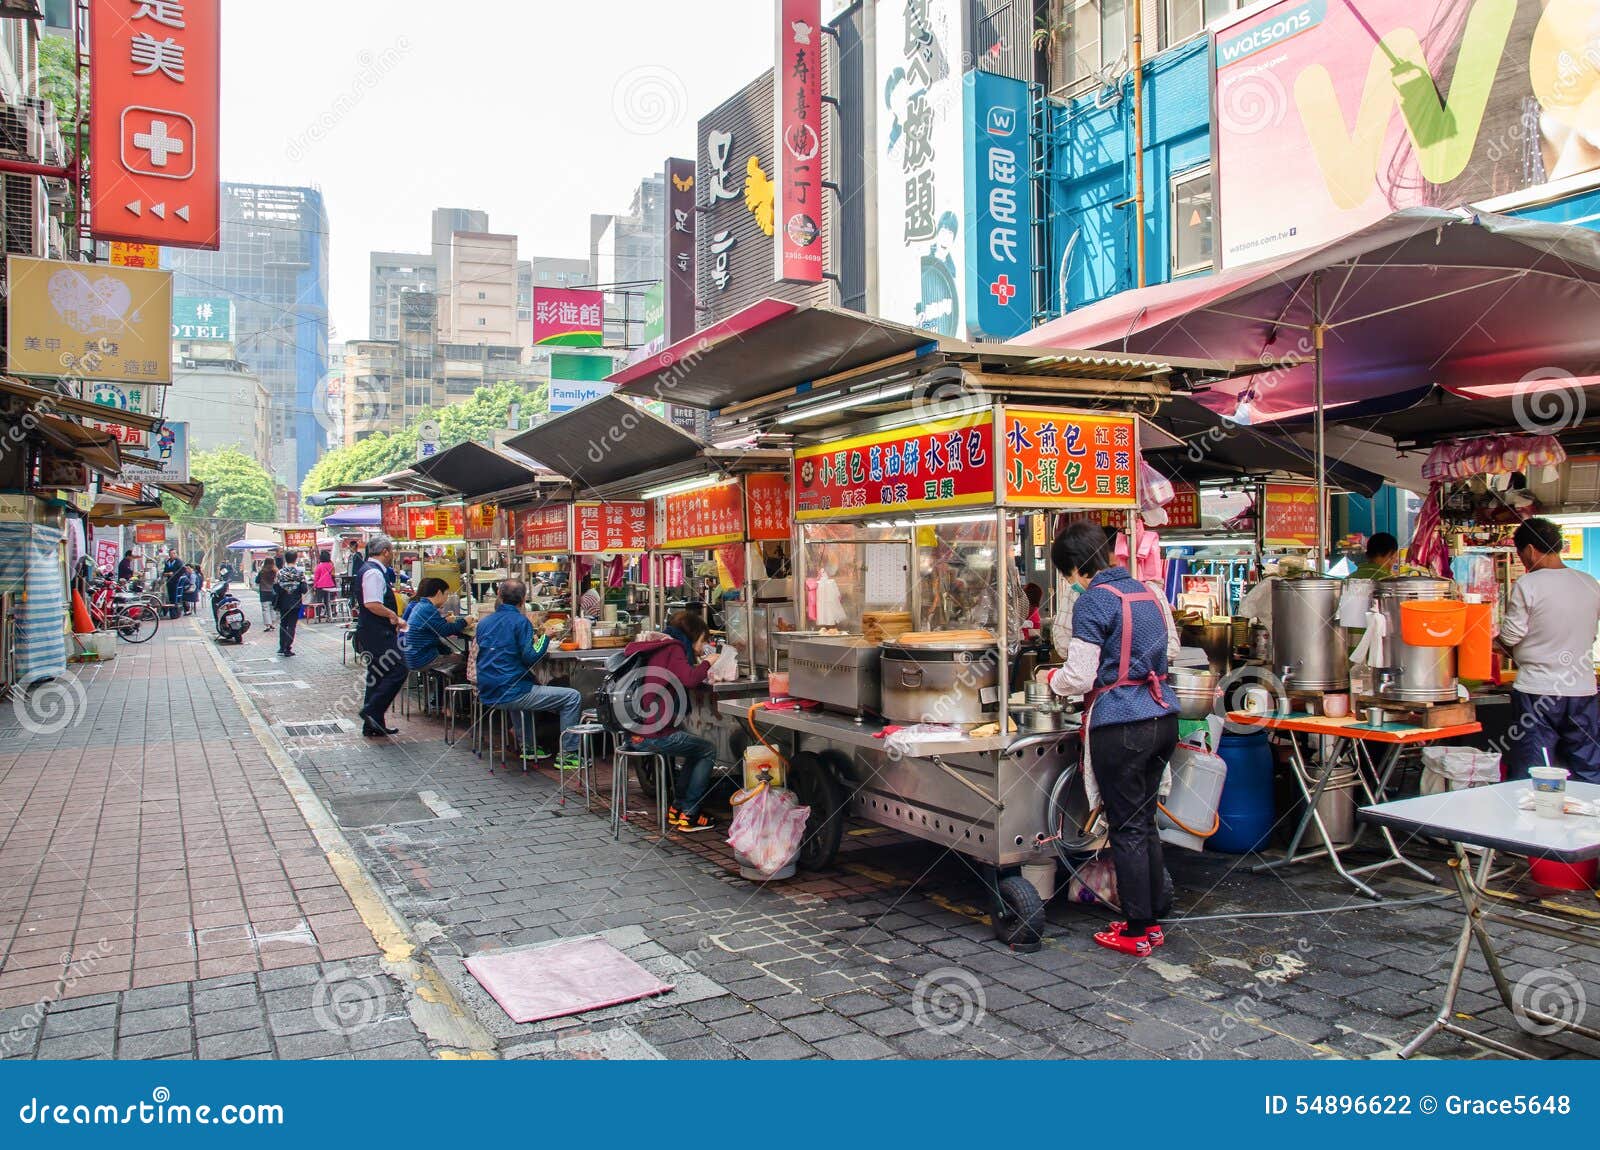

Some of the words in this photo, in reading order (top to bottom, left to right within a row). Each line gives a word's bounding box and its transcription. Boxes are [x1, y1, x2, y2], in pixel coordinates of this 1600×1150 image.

[1222, 9, 1312, 60] watsons
[988, 146, 1018, 264] 屈臣氏
[1230, 231, 1289, 253] watsons.com.tw
[537, 301, 601, 326] 彩遊館
[553, 387, 600, 400] FamilyM
[1007, 420, 1087, 457] 水煎包
[1095, 426, 1128, 446] 紅茶
[819, 451, 865, 488] 小籠包
[925, 432, 985, 475] 水煎包
[1007, 458, 1088, 494] 小籠包
[1095, 476, 1130, 495] 豆漿
[1095, 450, 1129, 470] 奶茶
[841, 488, 867, 508] 紅茶
[880, 483, 908, 505] 奶茶
[924, 478, 955, 501] 豆漿
